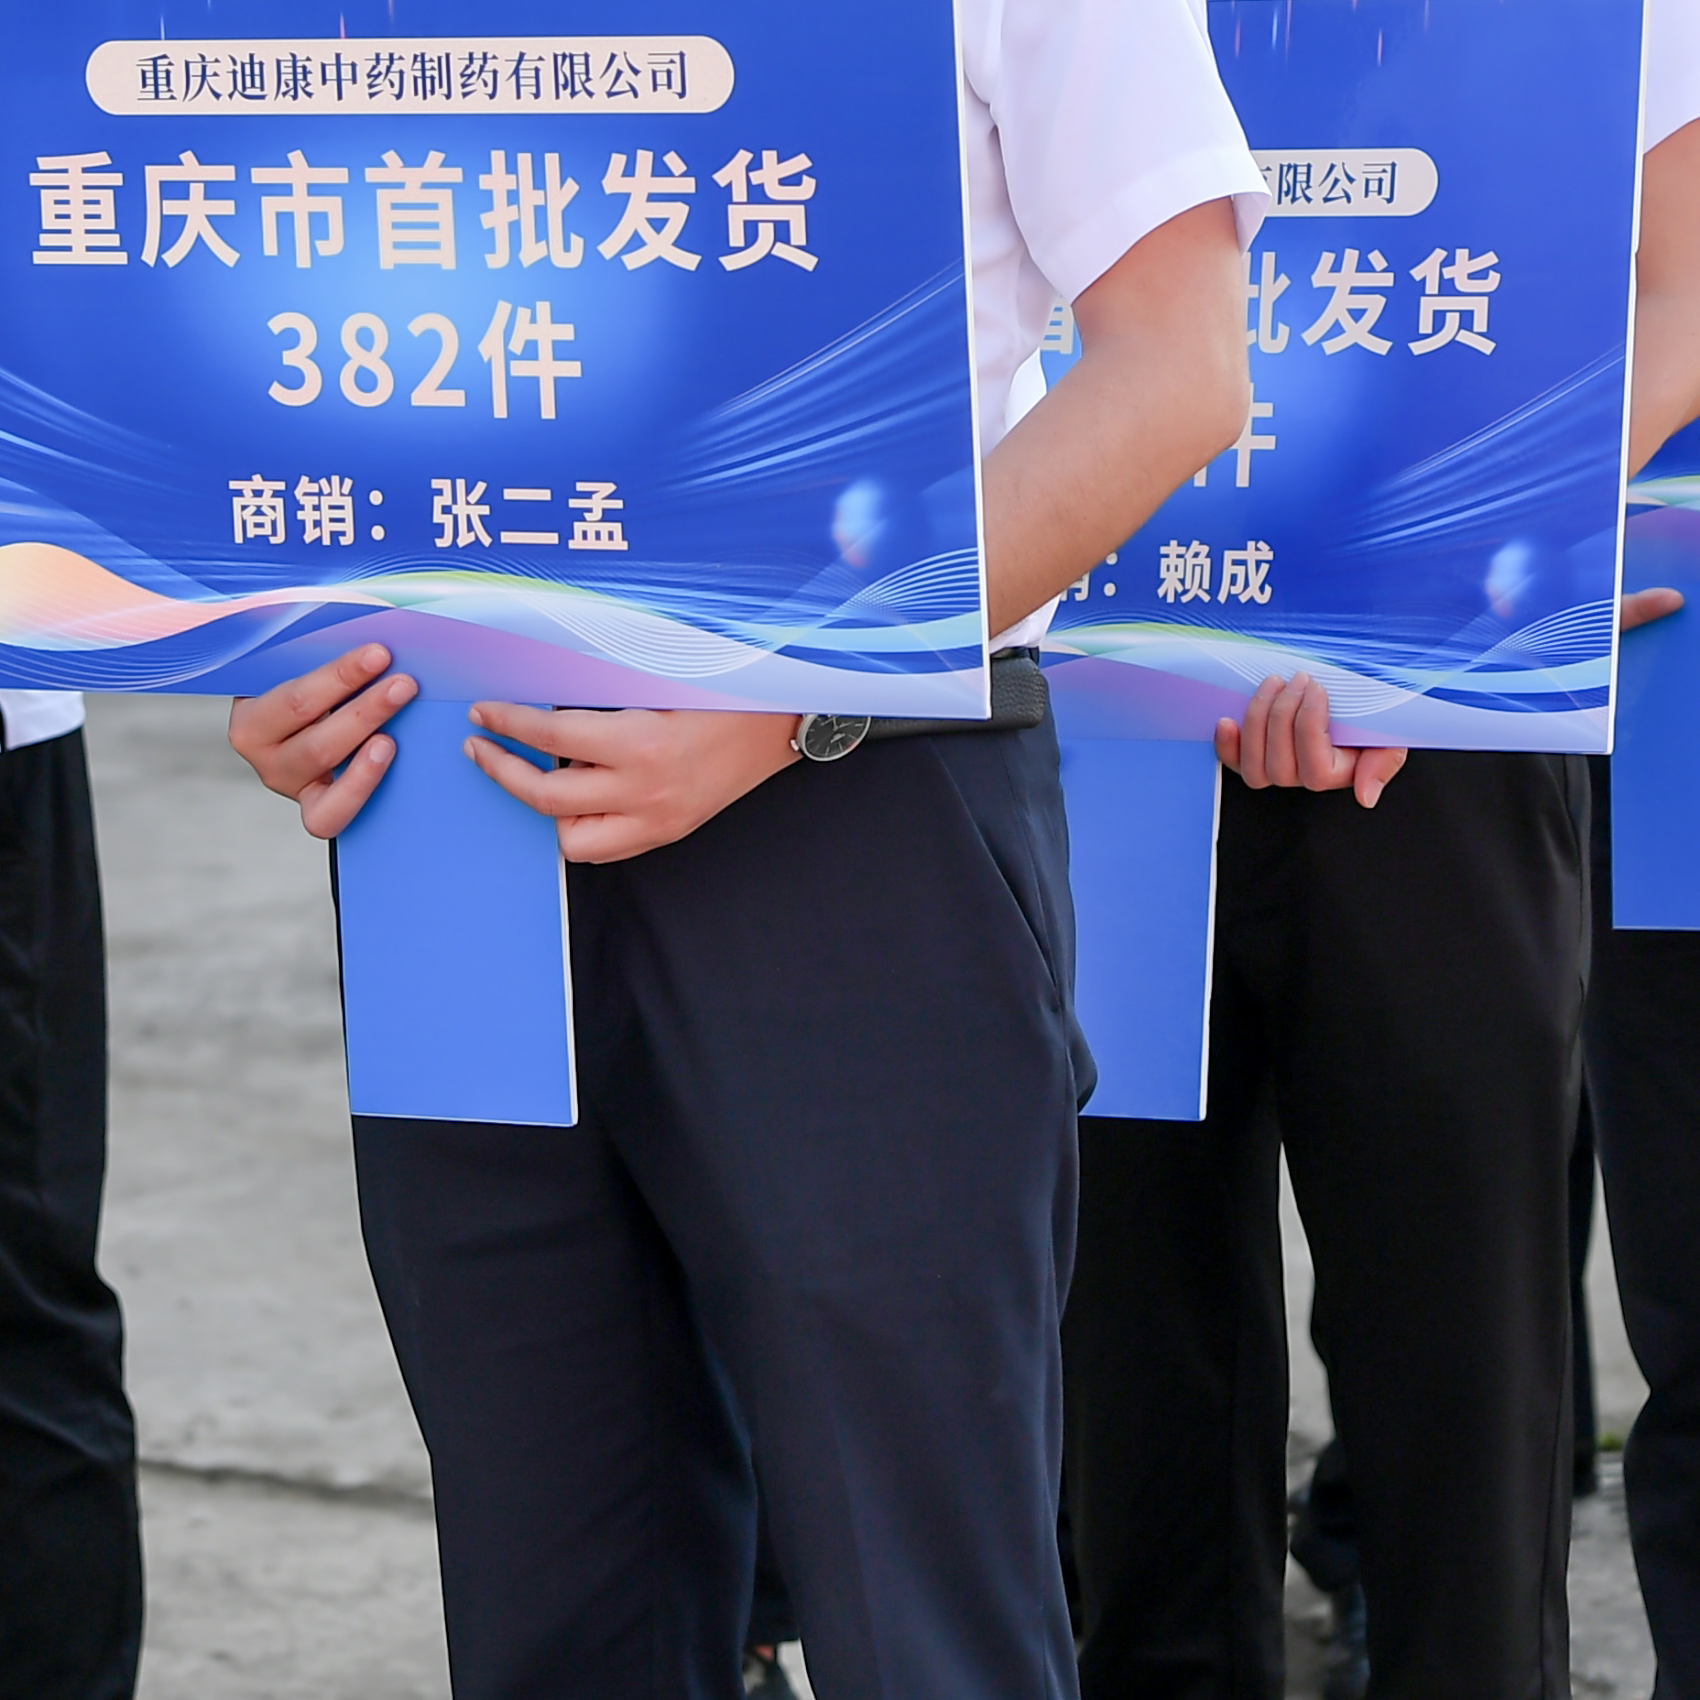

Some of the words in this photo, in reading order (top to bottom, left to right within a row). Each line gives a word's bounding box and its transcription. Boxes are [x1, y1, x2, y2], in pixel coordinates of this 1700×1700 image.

[135, 48, 689, 104] 重庆迪康中药制药有限公司
[28, 149, 820, 272] 重庆市首批发货
[266, 301, 582, 421] 382件
